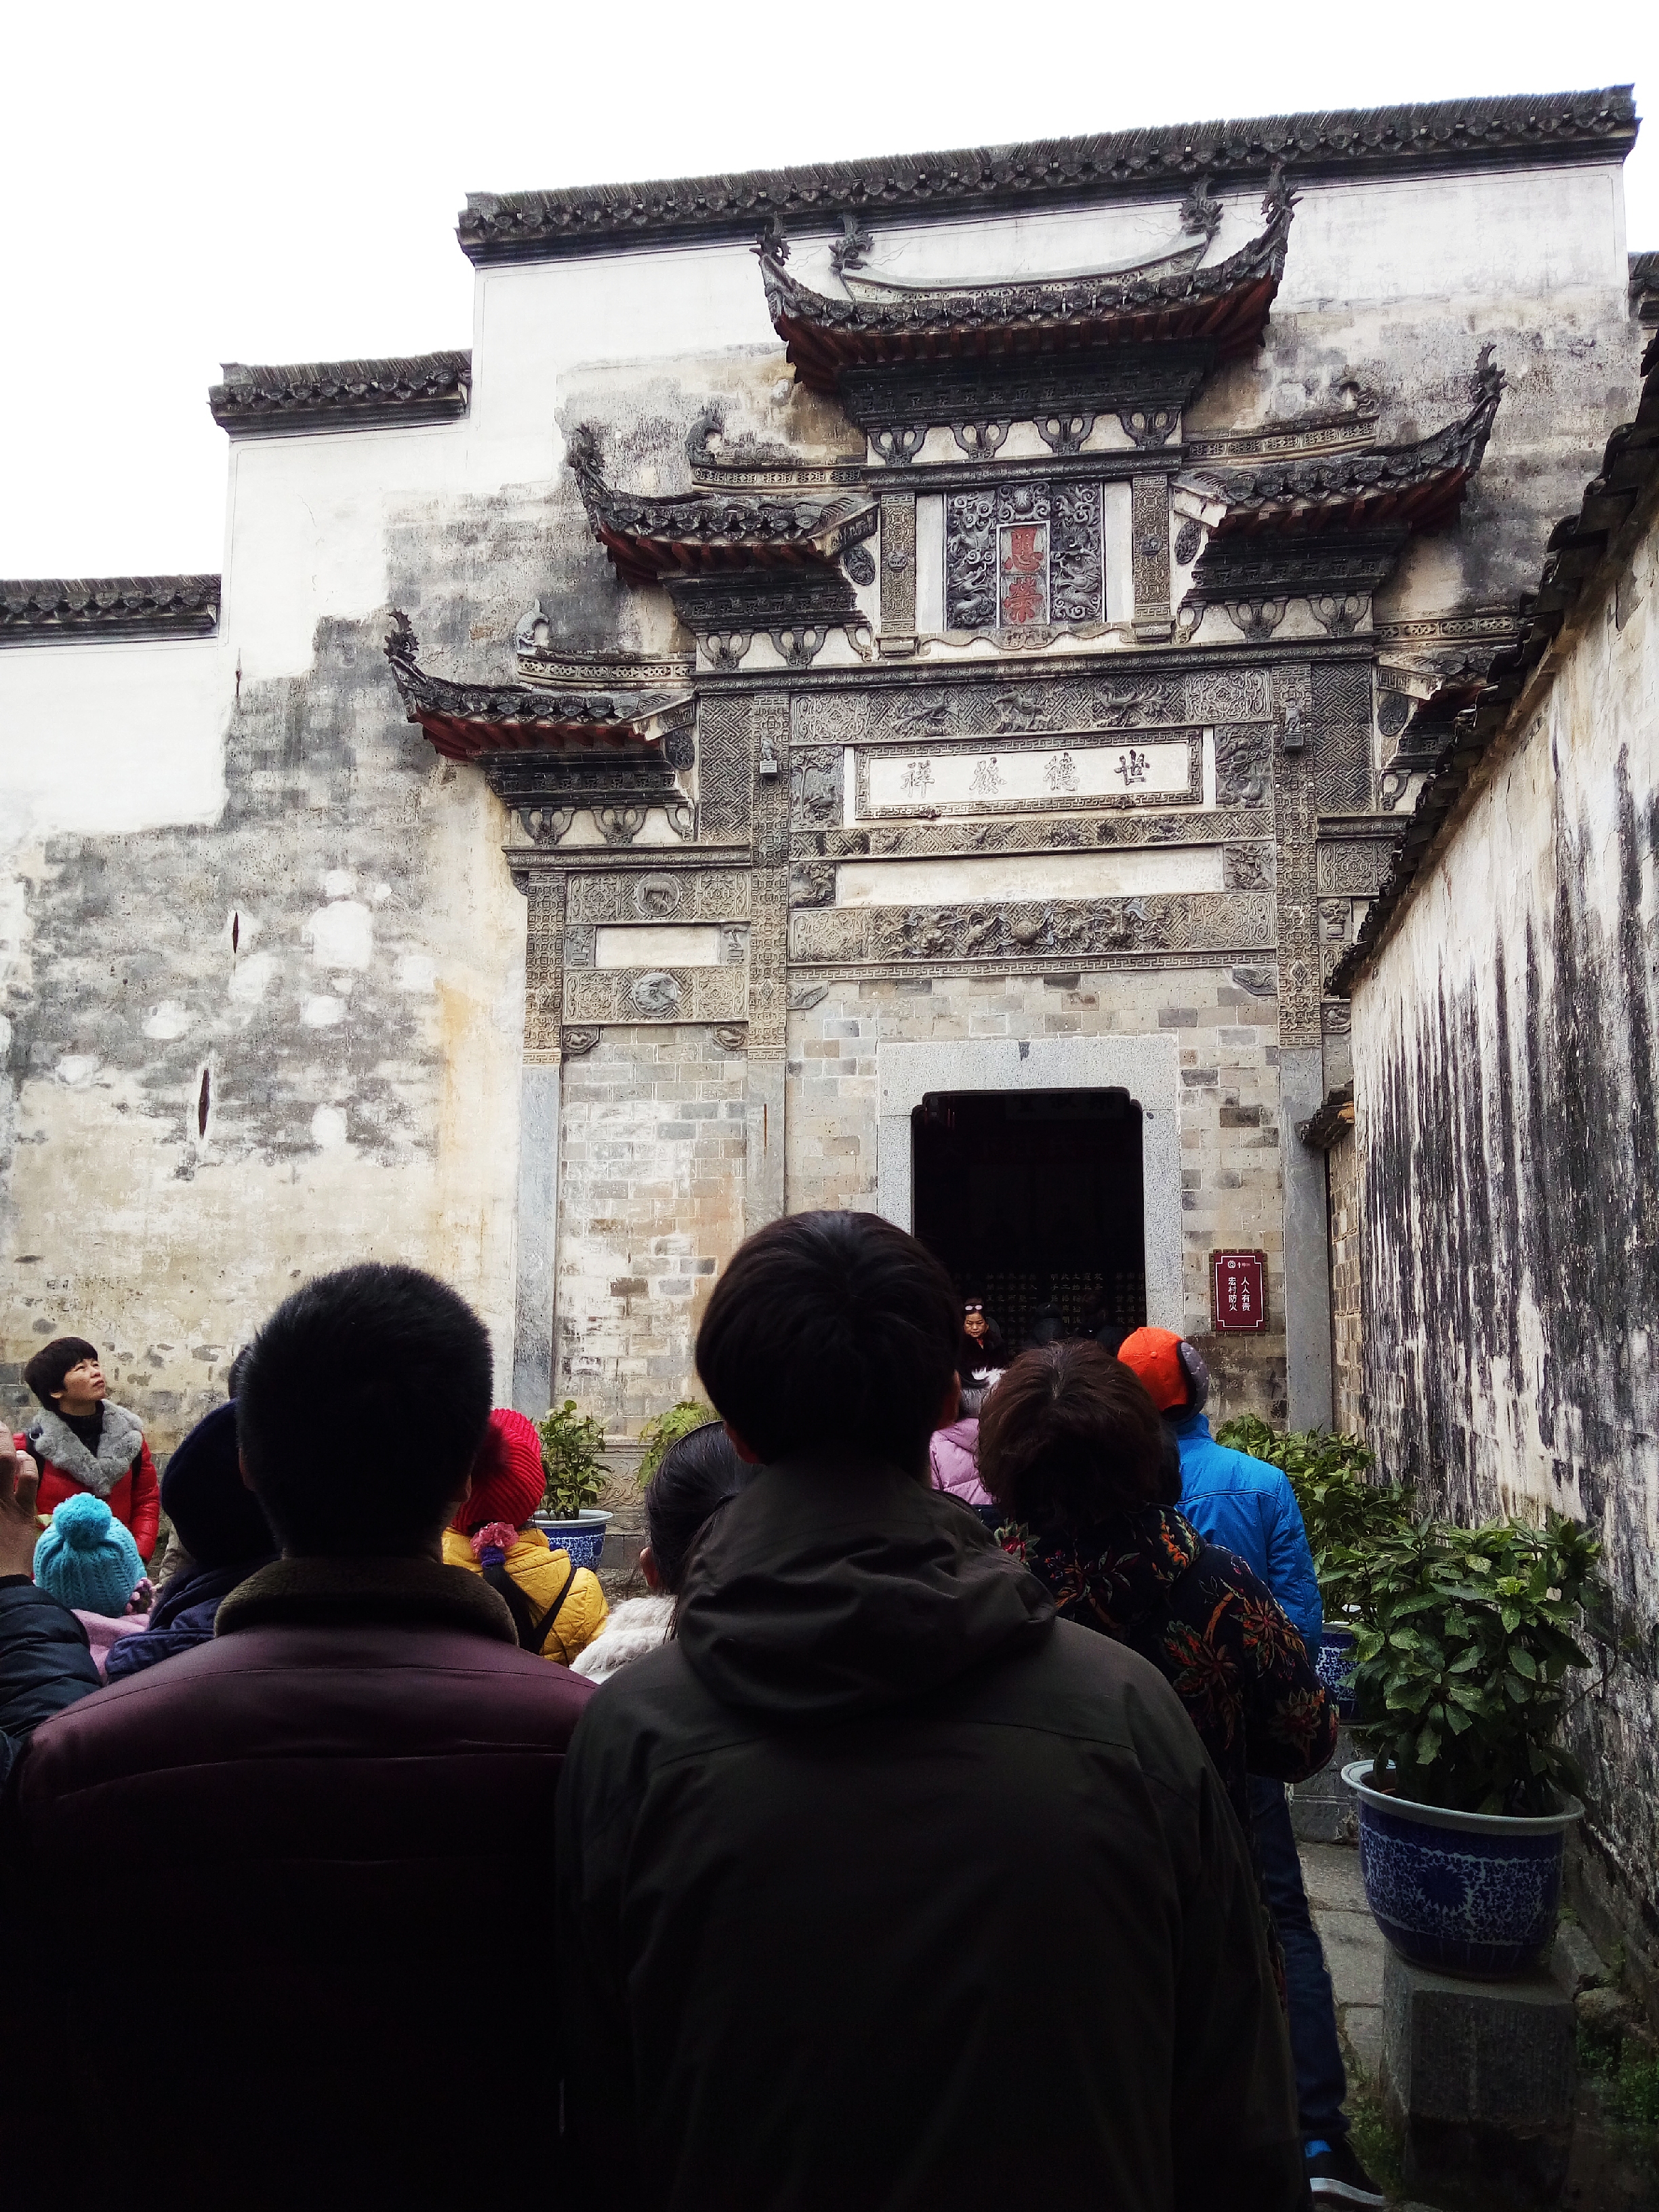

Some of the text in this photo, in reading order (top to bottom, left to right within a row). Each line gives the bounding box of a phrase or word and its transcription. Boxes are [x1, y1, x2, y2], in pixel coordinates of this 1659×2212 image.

[1228, 1277, 1238, 1311] 宏村防火
[1241, 1277, 1251, 1311] 人人有责
